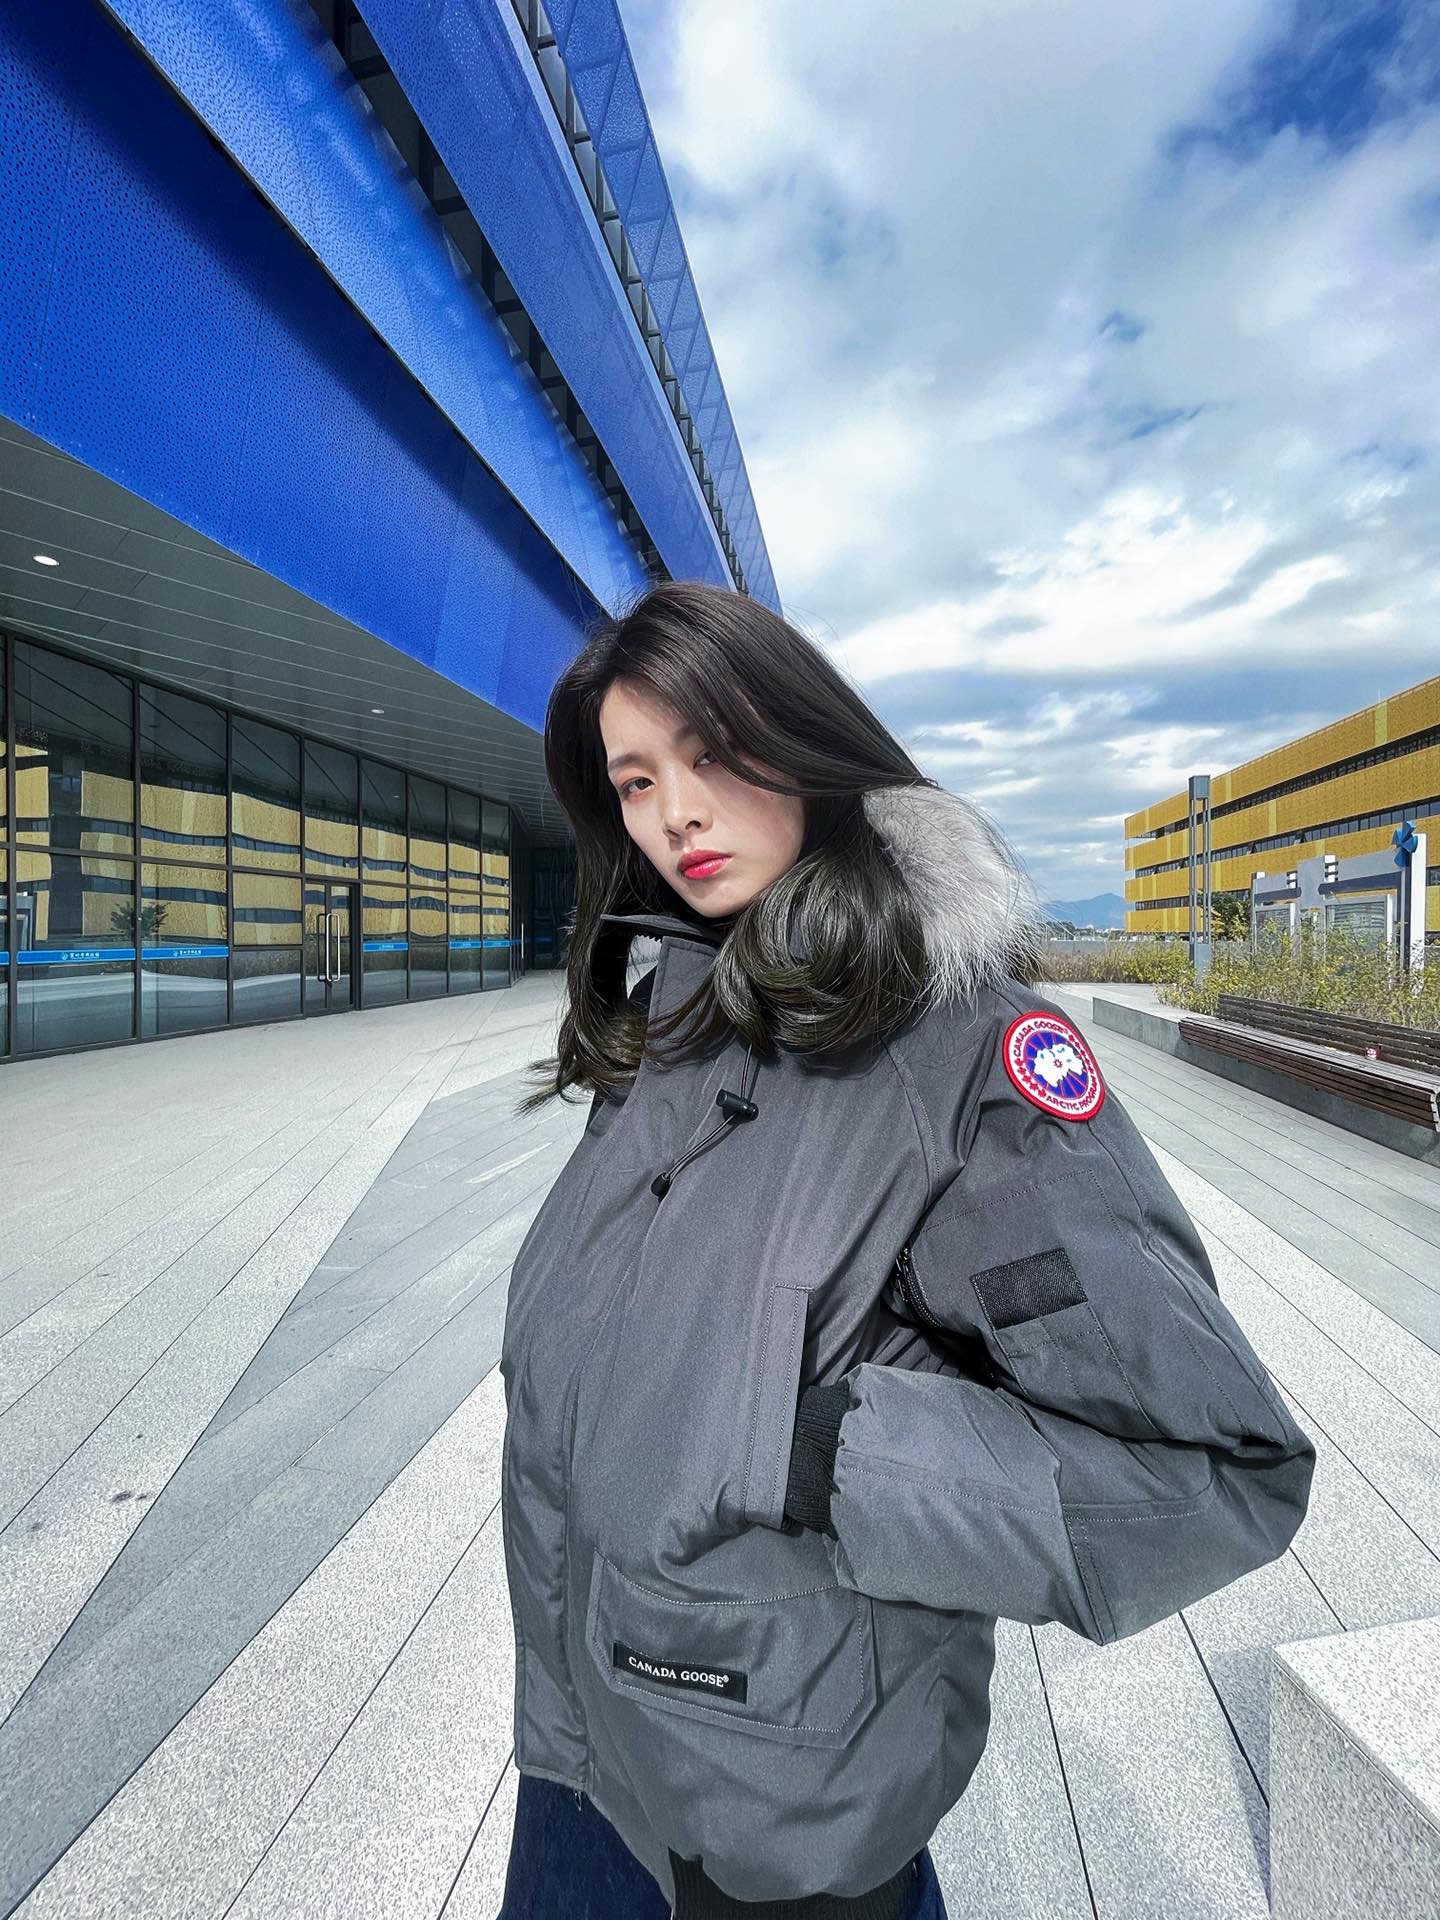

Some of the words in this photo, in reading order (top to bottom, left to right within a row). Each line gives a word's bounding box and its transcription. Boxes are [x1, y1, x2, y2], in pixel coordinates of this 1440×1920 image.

[1013, 1024, 1035, 1057] CANADA
[1046, 1095, 1080, 1111] ARCTIC
[628, 1656, 677, 1679] CANADA
